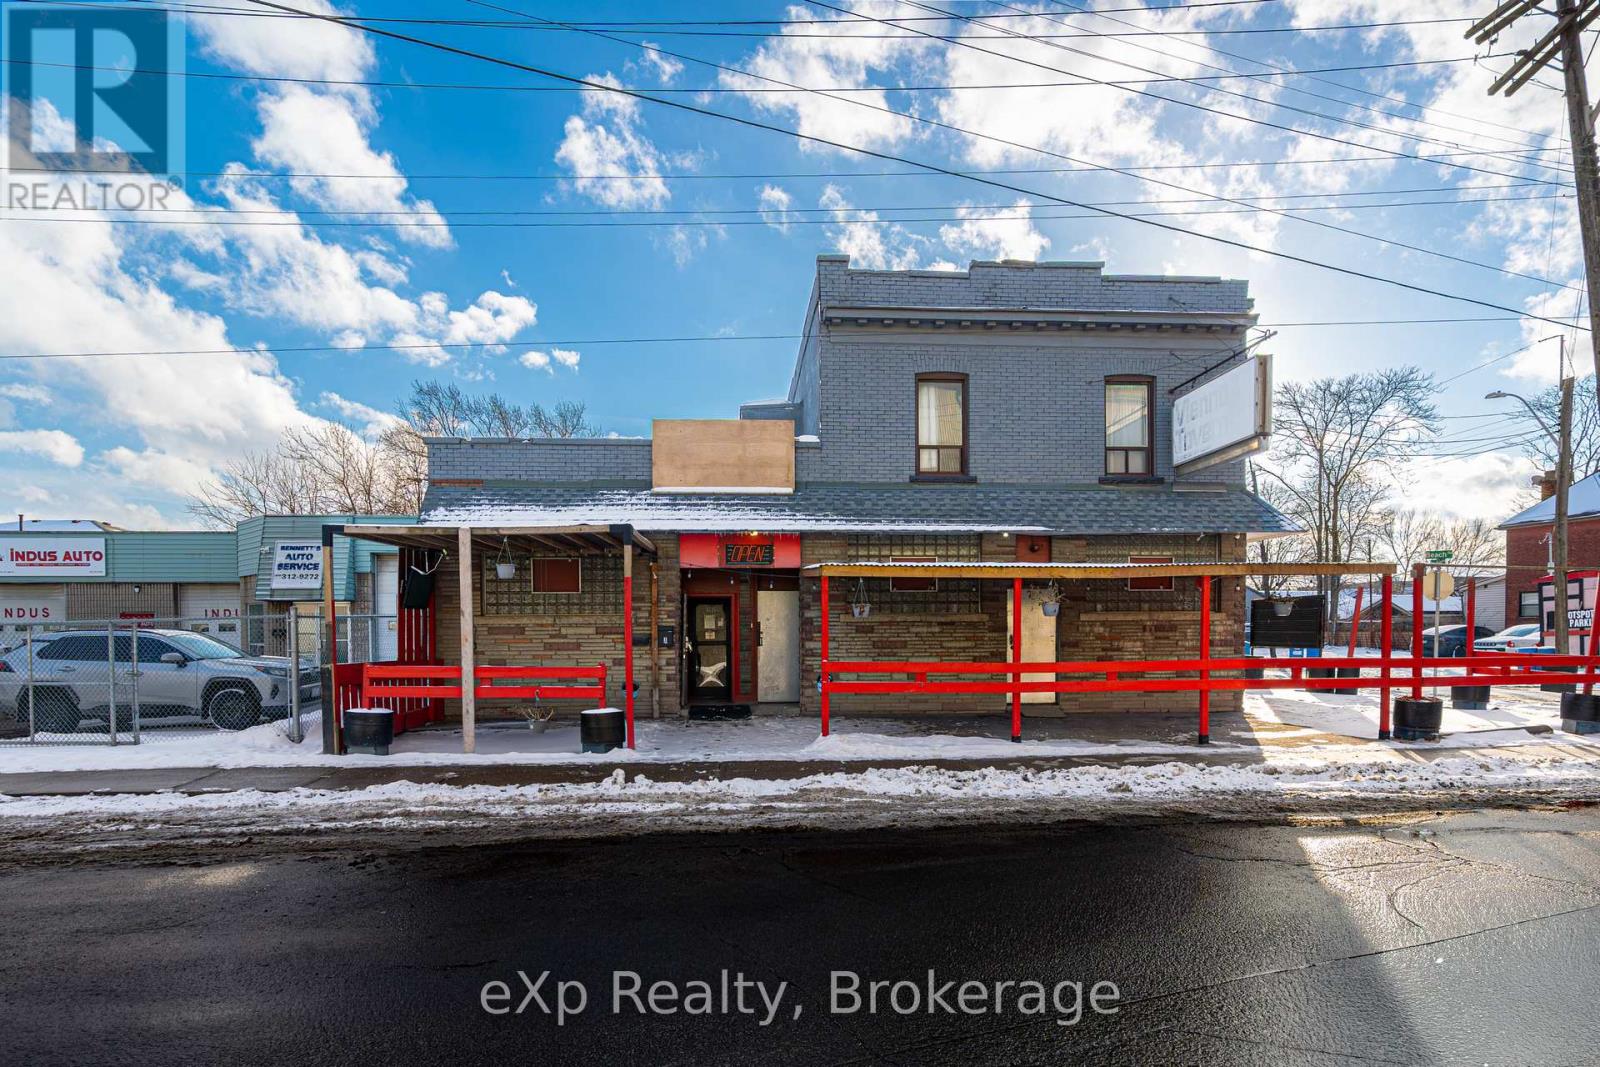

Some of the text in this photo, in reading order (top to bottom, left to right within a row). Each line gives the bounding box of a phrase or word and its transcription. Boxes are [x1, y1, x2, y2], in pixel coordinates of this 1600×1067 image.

[62, 551, 103, 561] AUTO
[731, 545, 765, 562] OPEN
[4, 607, 49, 618] NDUS
[1567, 609, 1595, 619] OTSPOT
